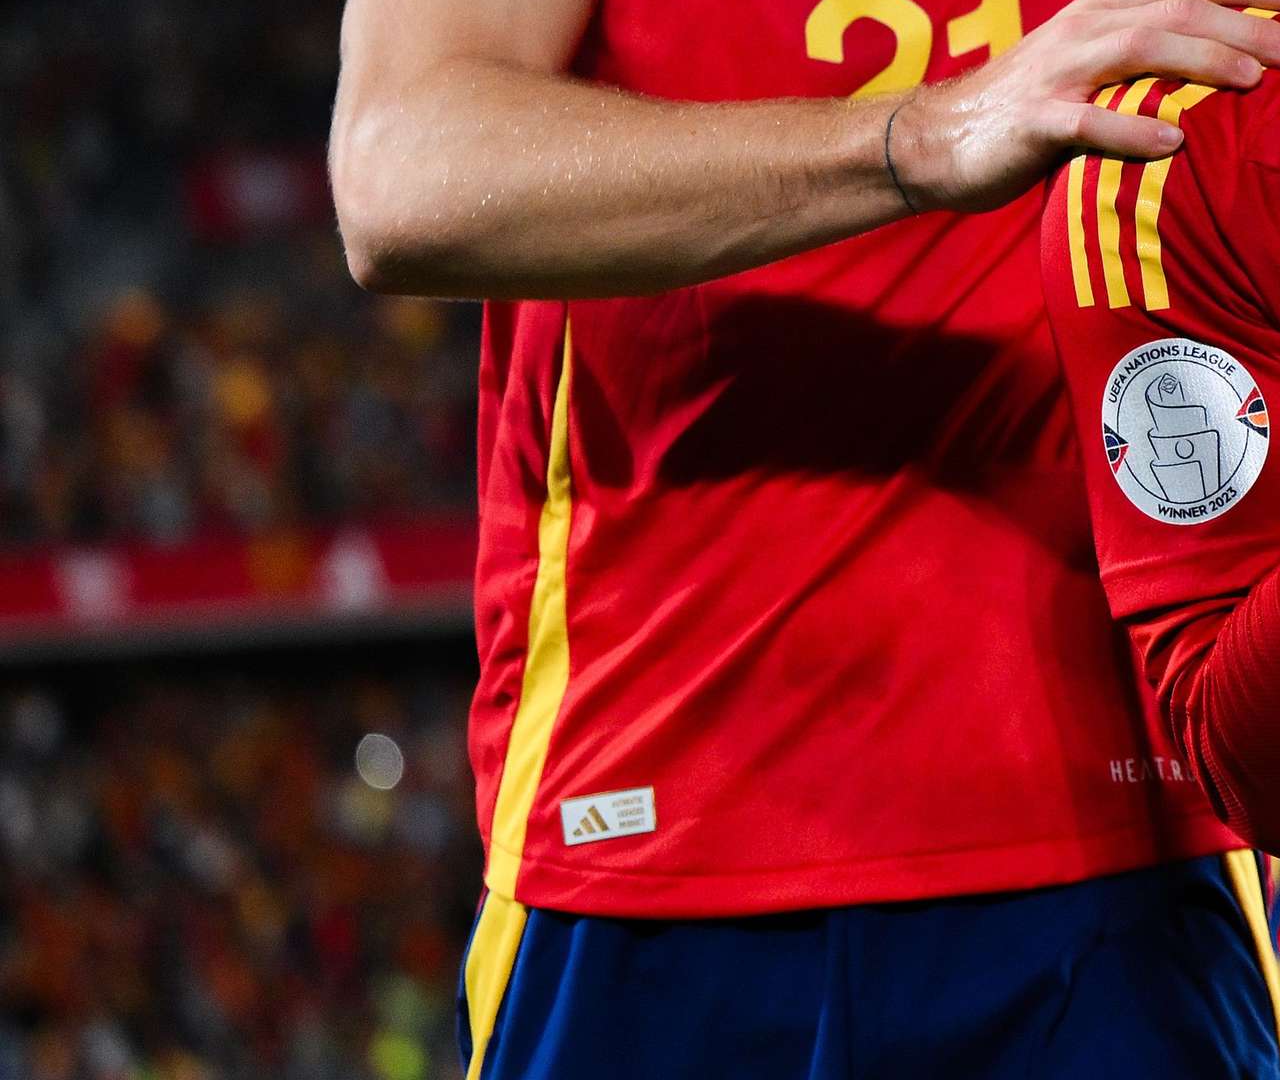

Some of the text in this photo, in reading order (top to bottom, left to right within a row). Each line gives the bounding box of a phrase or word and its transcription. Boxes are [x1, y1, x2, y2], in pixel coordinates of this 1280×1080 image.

[1109, 345, 1236, 404] UEFA NATIONS LEAGUE
[1158, 487, 1238, 519] WINNER 2023
